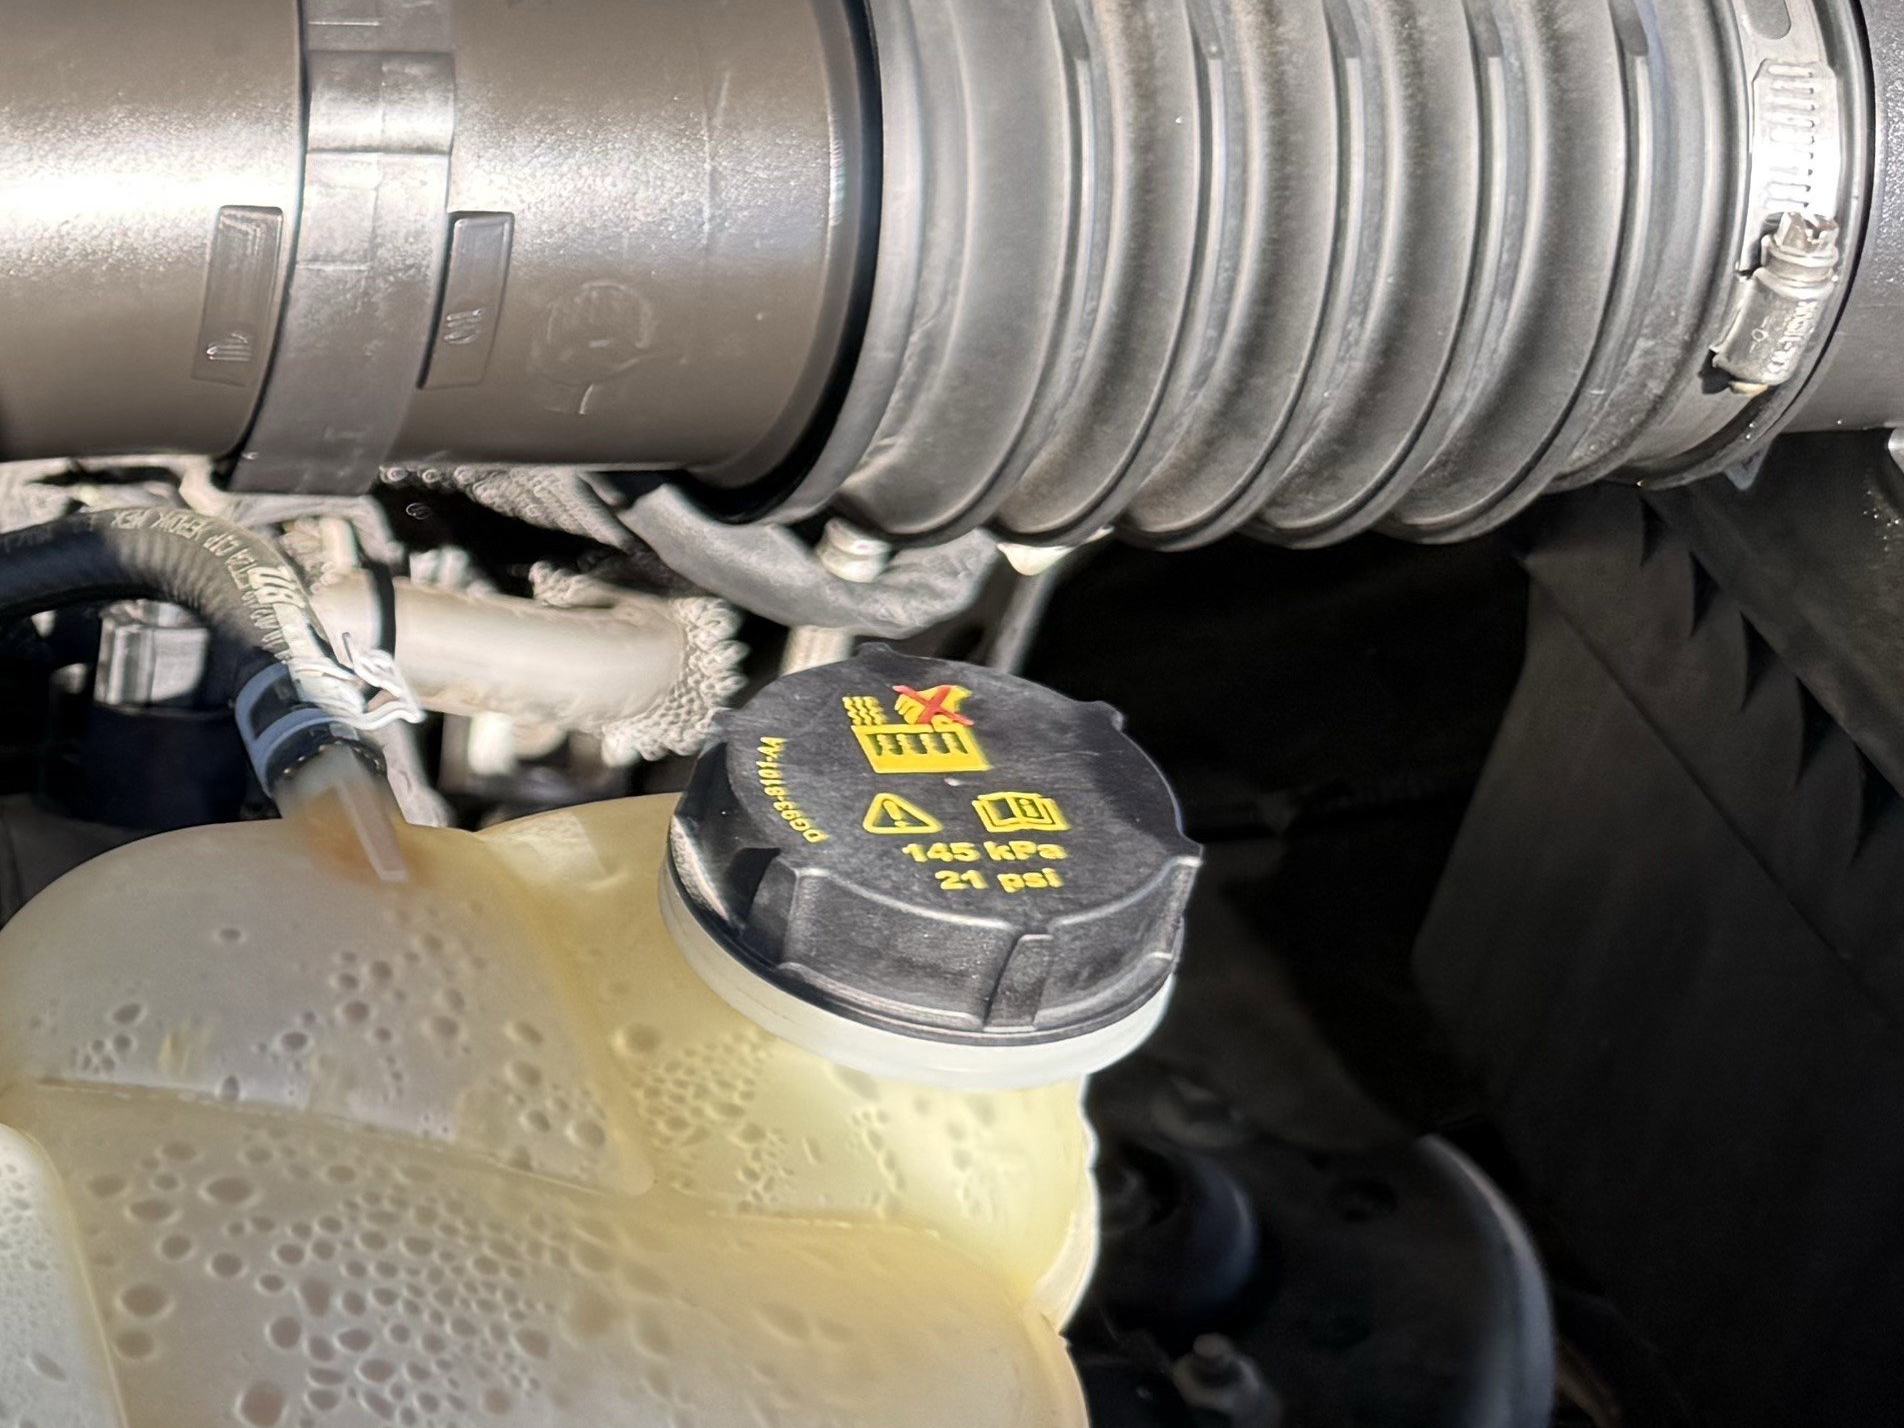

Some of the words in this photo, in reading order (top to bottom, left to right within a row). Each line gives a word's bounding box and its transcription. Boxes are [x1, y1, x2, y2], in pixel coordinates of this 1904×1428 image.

[902, 841, 981, 863] 145
[983, 840, 1069, 861] kPa
[934, 869, 989, 890] 21
[997, 867, 1065, 893] psi
